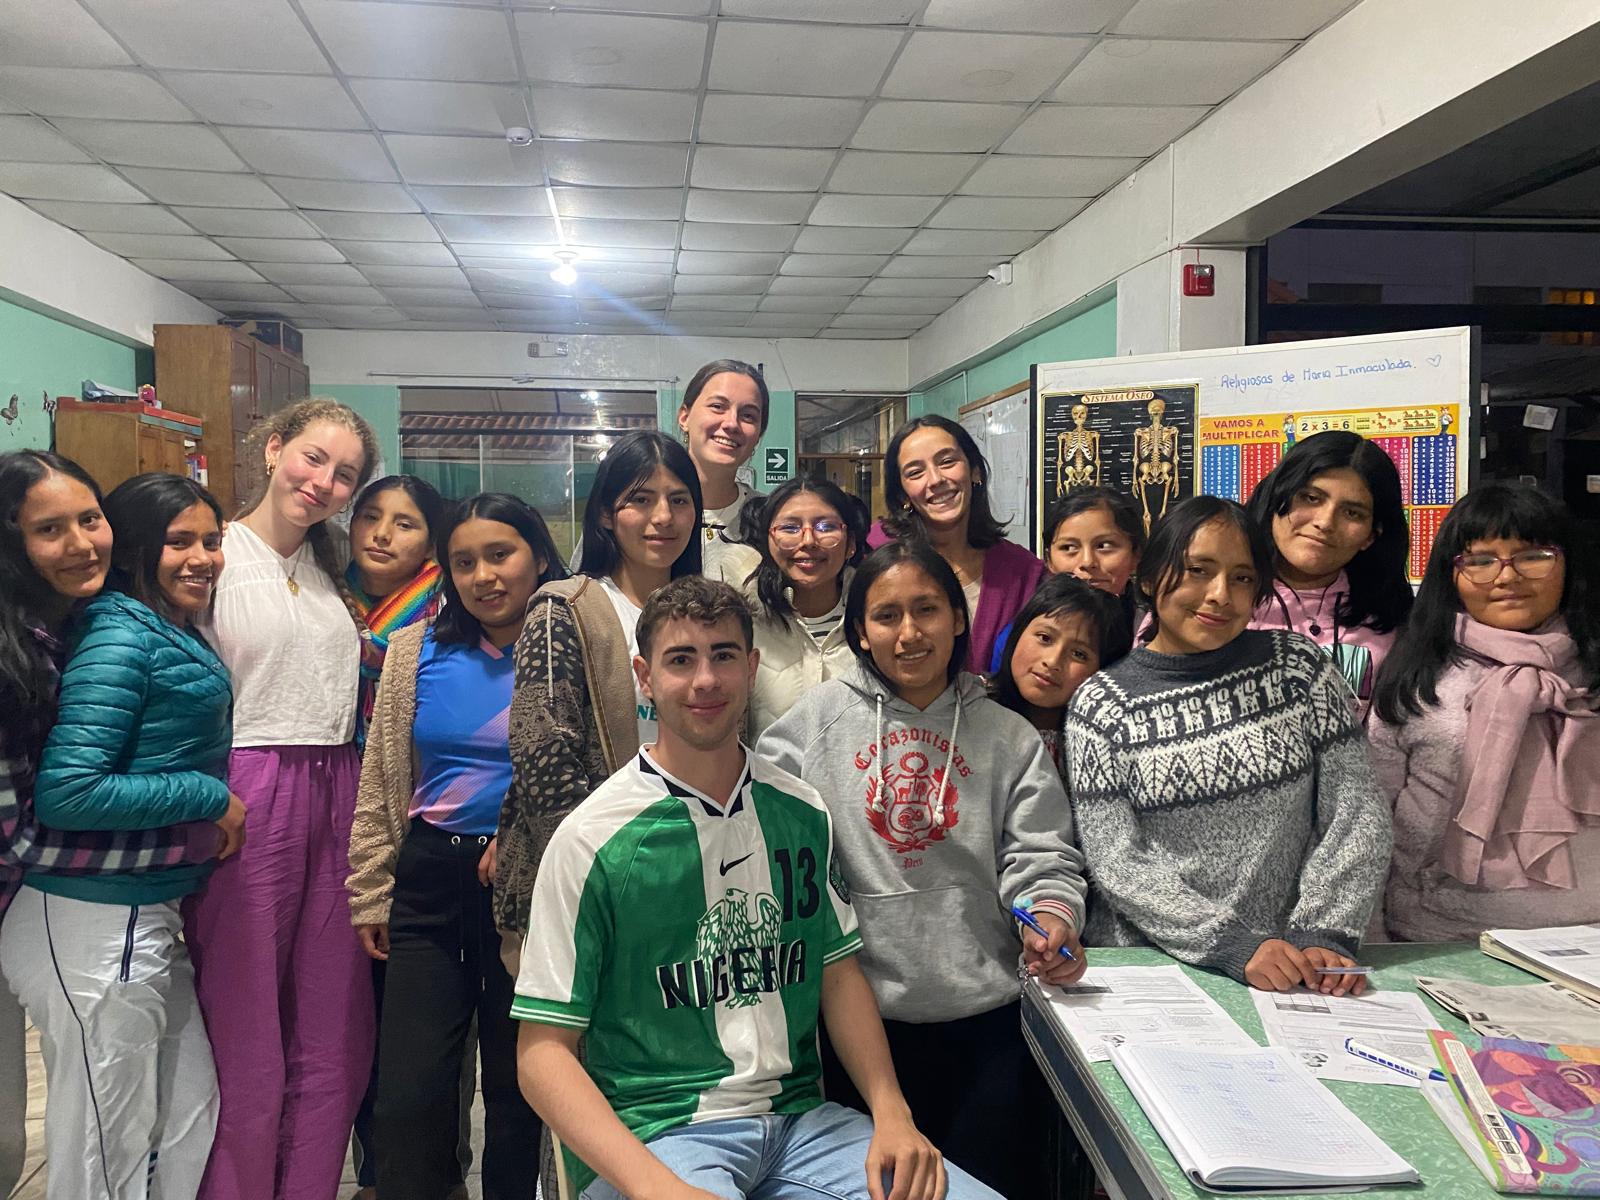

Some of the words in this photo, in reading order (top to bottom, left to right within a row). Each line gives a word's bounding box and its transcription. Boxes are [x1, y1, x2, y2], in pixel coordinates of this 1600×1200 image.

[1221, 374, 1273, 394] Religiosas
[1282, 370, 1295, 382] de
[1084, 394, 1124, 403] SISTEMA
[1214, 419, 1254, 429] VAMOS
[1256, 418, 1265, 427] A
[1302, 423, 1308, 431] 2
[1322, 422, 1328, 430] 3
[1342, 420, 1350, 429] 6
[1202, 430, 1280, 440] MULTIPLICAR
[774, 847, 820, 922] 13
[656, 939, 807, 1009] NIGERIA
